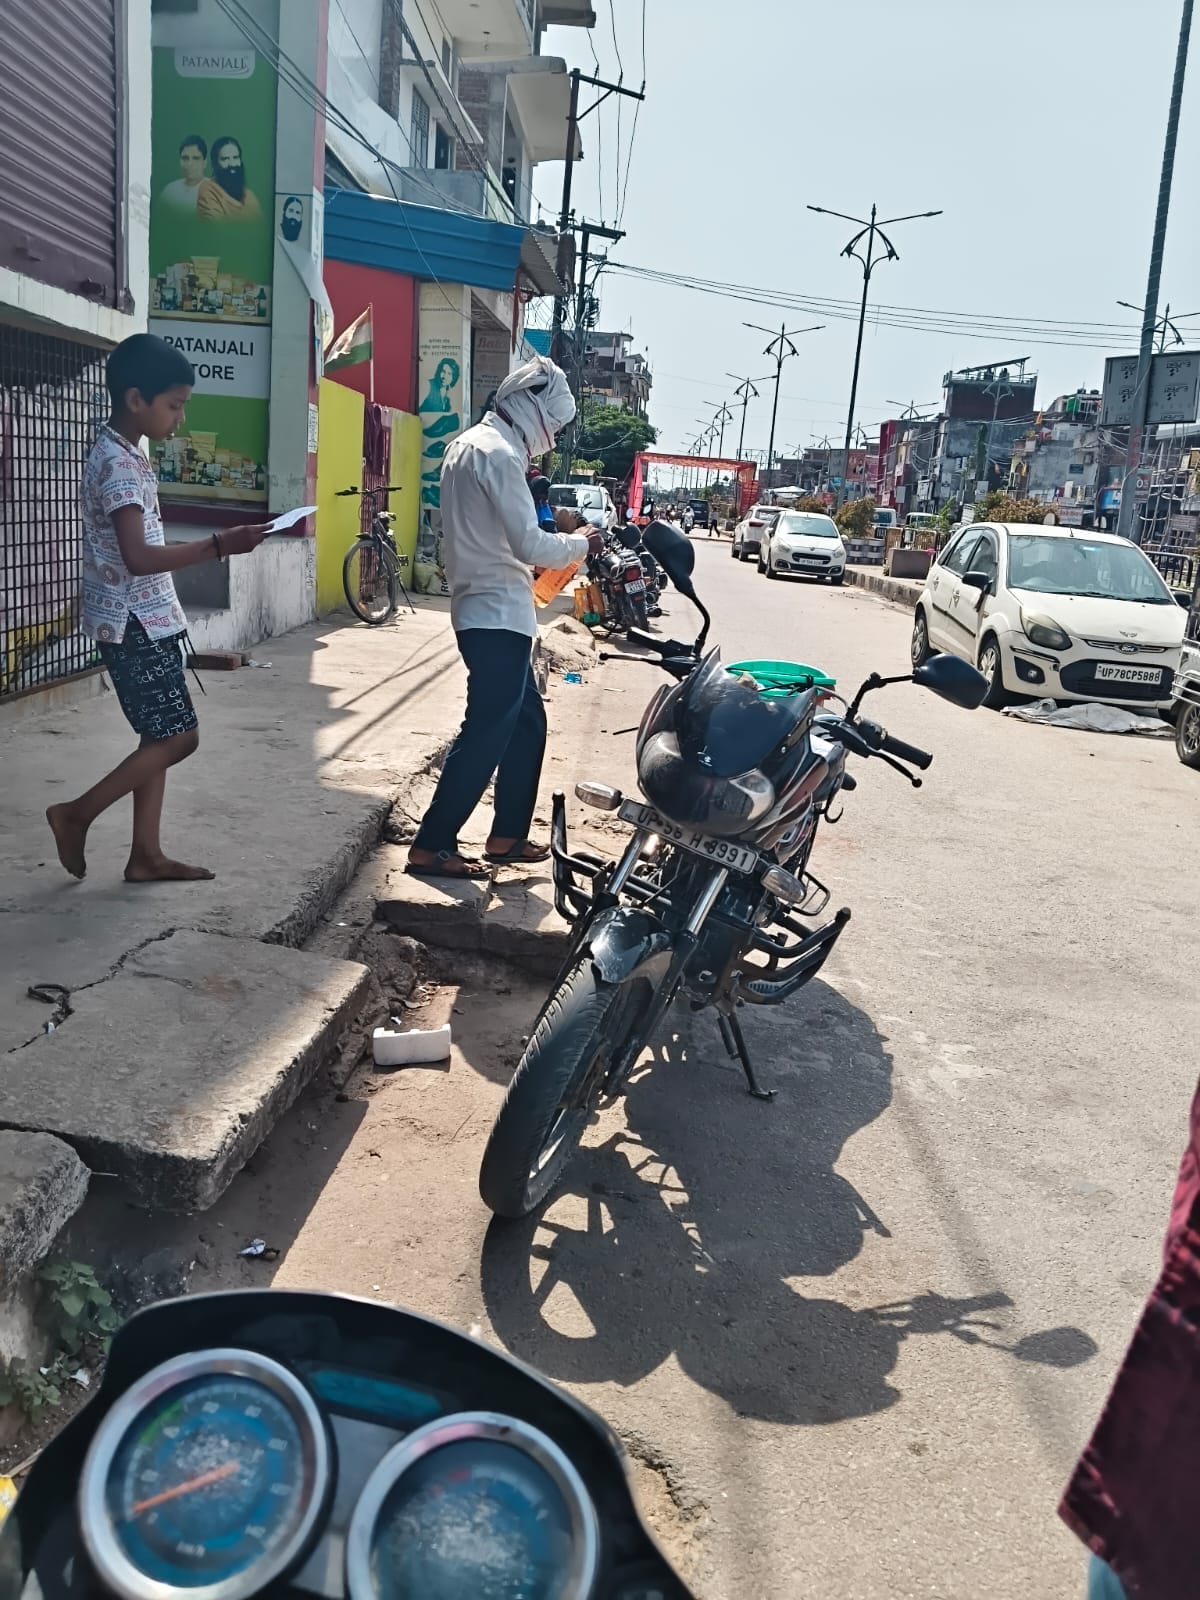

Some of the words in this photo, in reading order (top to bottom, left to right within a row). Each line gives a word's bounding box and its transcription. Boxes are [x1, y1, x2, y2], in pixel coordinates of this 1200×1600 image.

[181, 55, 246, 70] PATANJALI
[163, 335, 254, 357] PATANJALI
[191, 363, 235, 380] TORE
